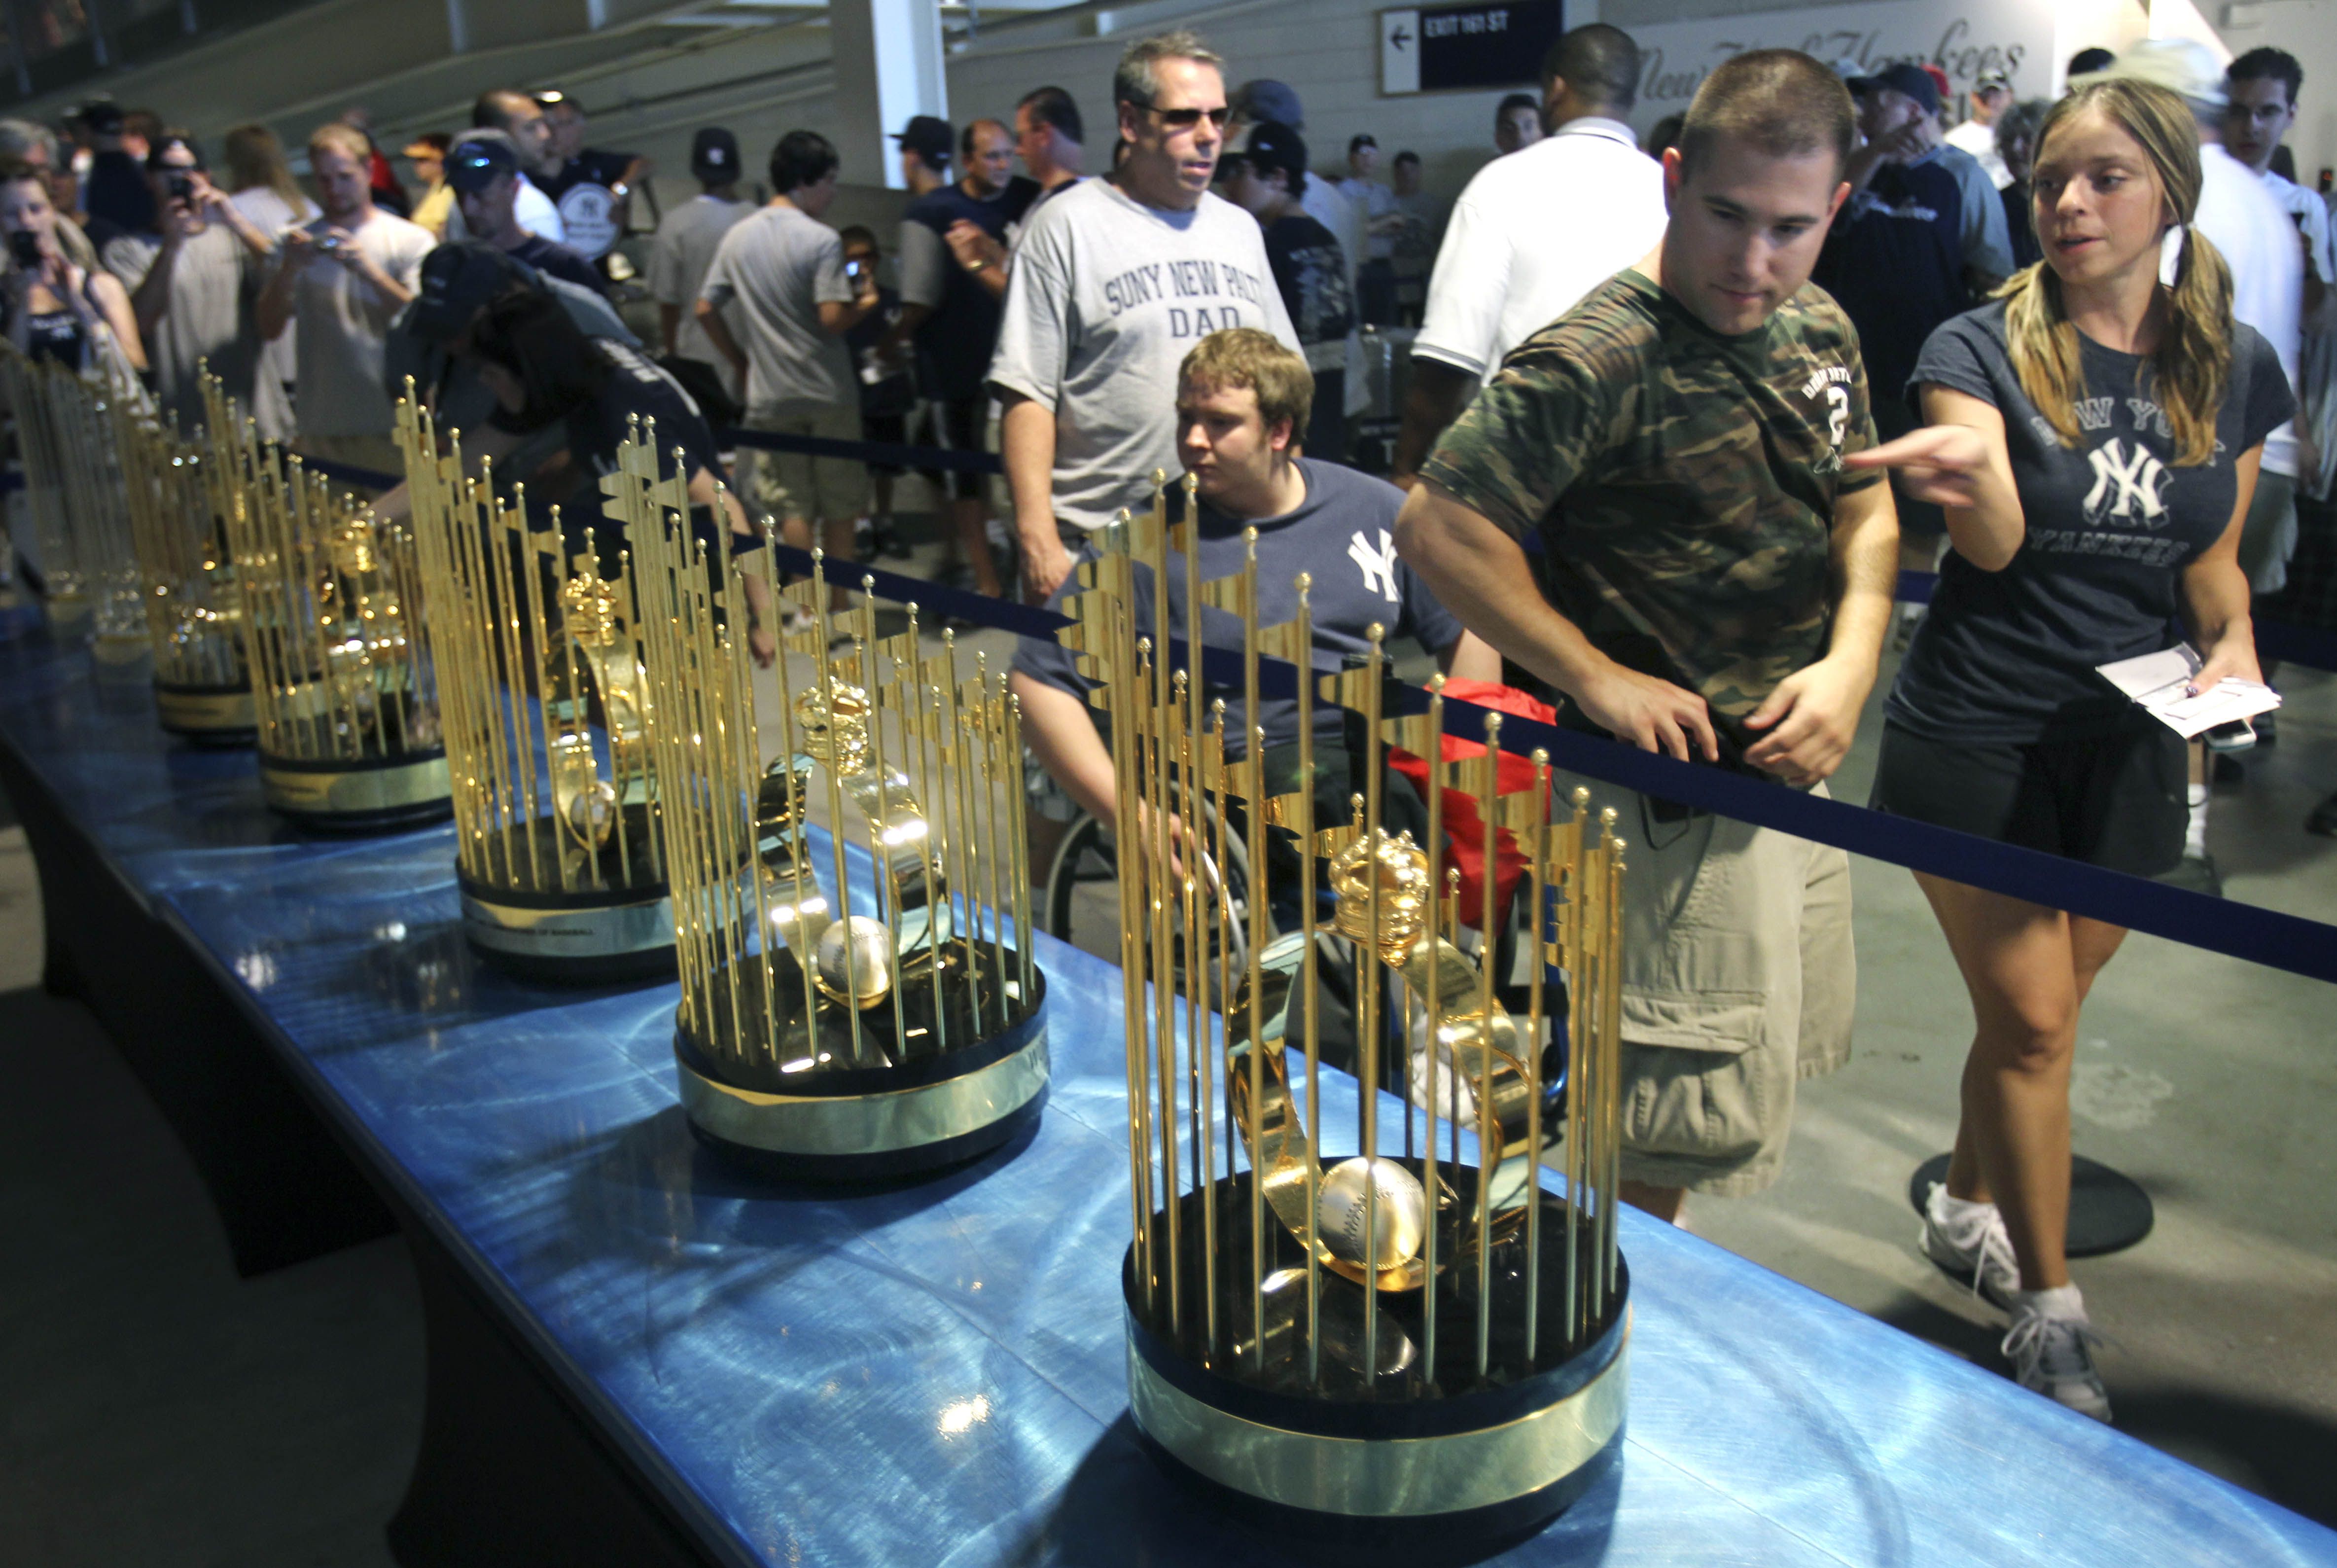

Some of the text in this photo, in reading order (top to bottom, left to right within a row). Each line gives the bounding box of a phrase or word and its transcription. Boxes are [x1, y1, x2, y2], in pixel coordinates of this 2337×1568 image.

[1105, 263, 1164, 316] SUNY
[1168, 259, 1219, 297] NEW
[1169, 307, 1241, 338] DAD
[2030, 396, 2114, 446] NW
[2083, 437, 2171, 527] NY
[1347, 528, 1399, 603] NY
[2027, 526, 2191, 568] YANKEES
